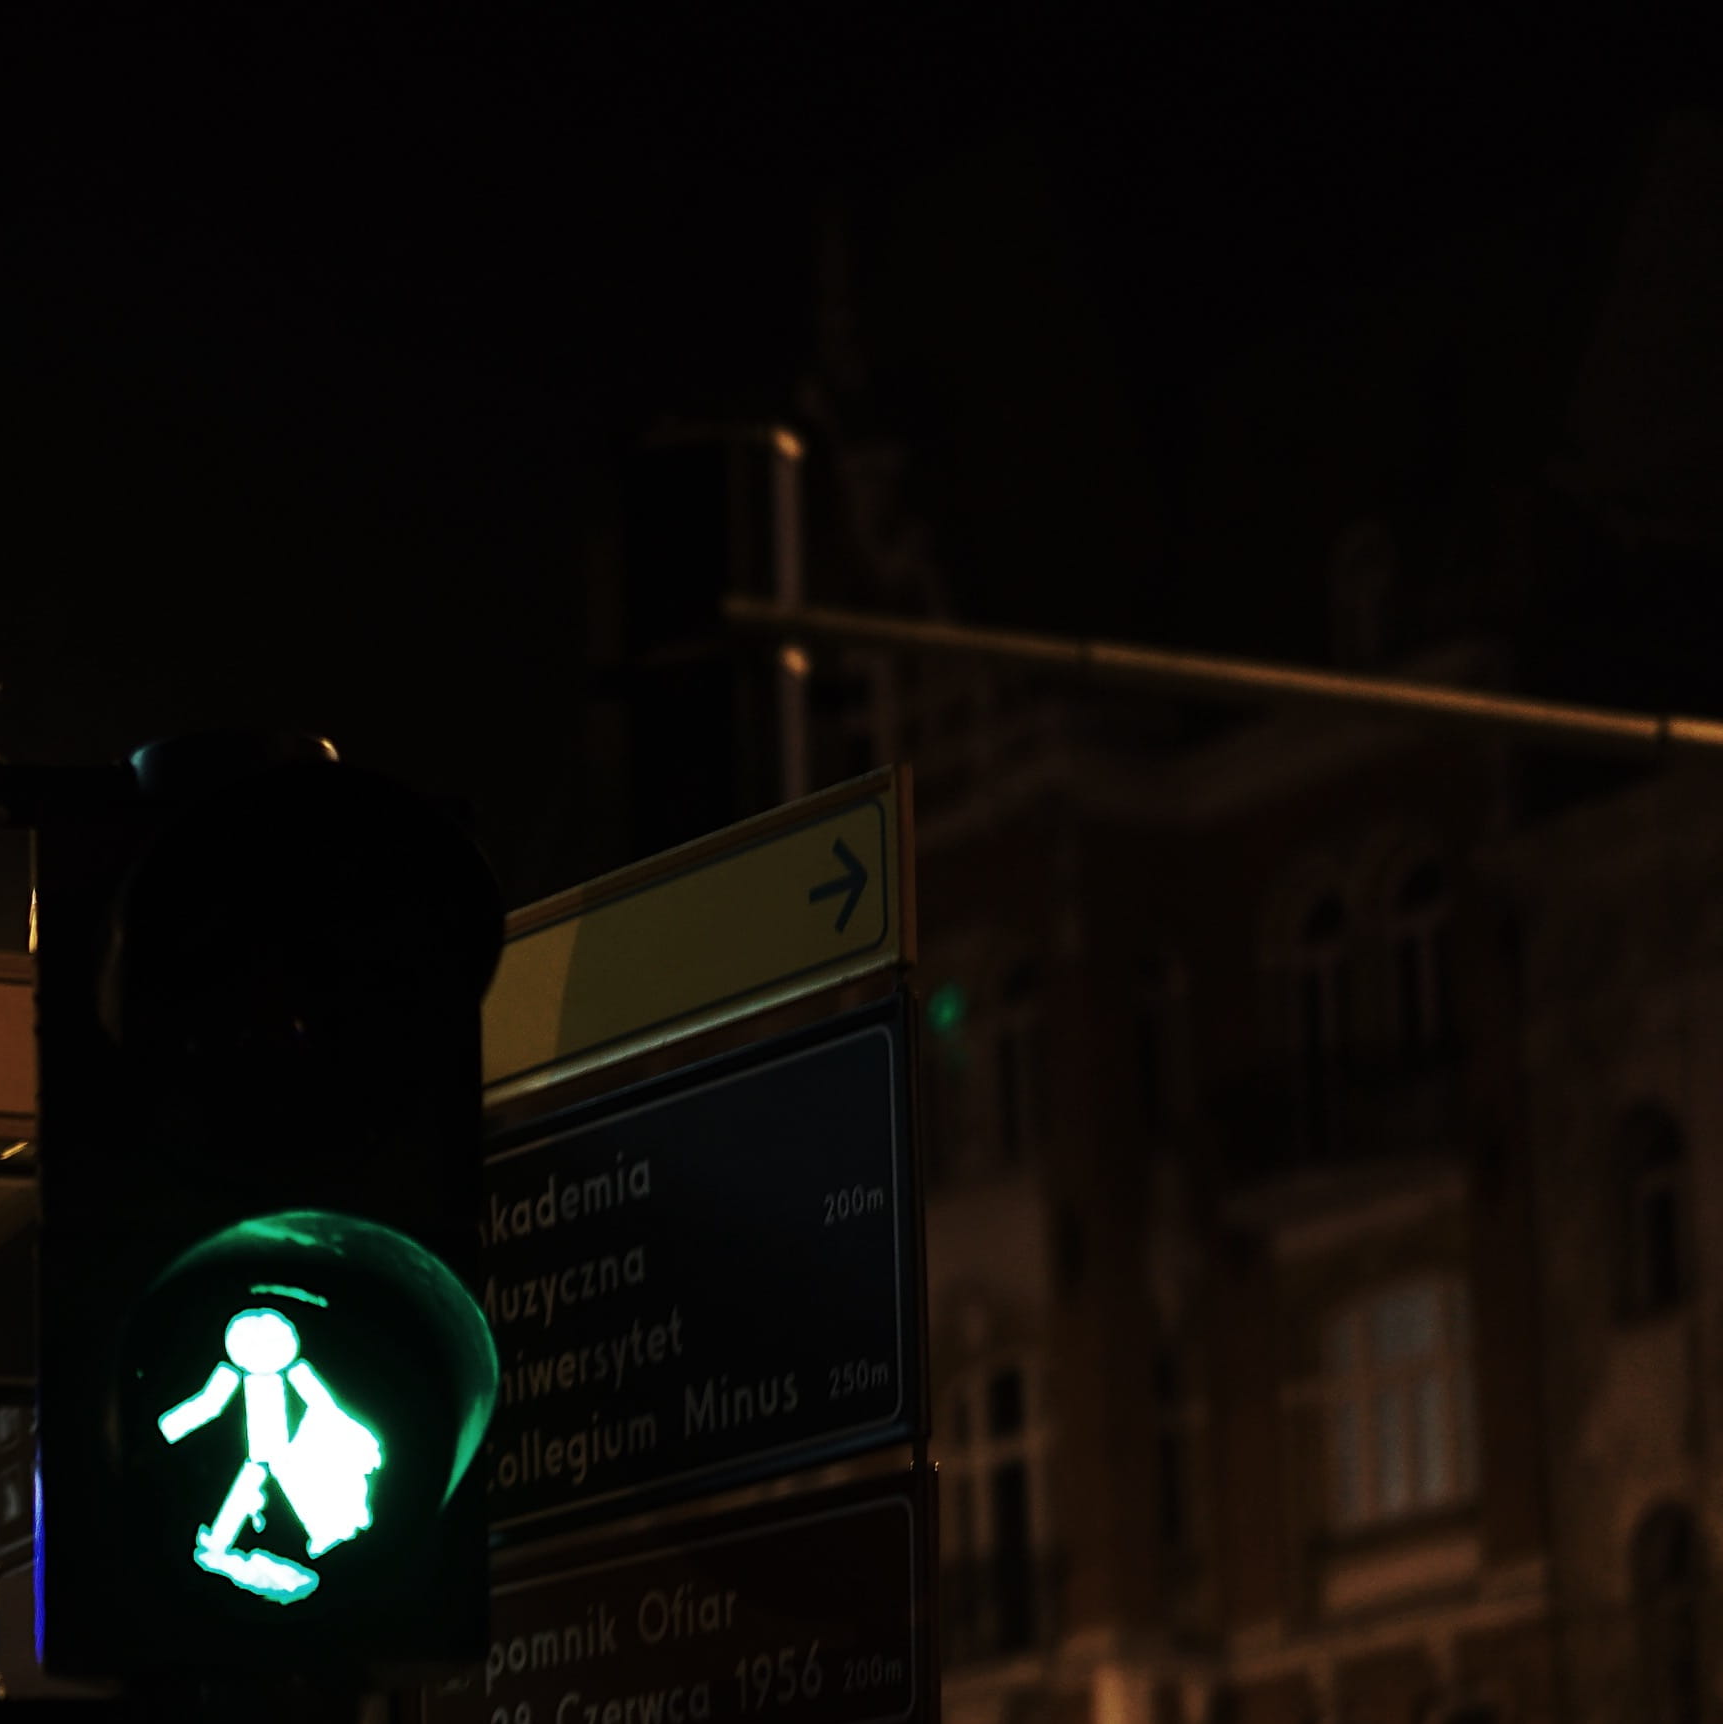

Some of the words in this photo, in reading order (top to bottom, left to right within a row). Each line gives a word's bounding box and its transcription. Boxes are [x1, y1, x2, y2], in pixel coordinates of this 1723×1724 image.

[822, 1184, 884, 1225] 200m
[502, 1304, 683, 1407] niwersytet
[485, 1410, 659, 1495] ollegium
[684, 1371, 799, 1438] Minus
[827, 1358, 889, 1399] 250m
[637, 1578, 738, 1645] Ofiar
[734, 1637, 823, 1712] 1956
[842, 1653, 903, 1694] 200m
